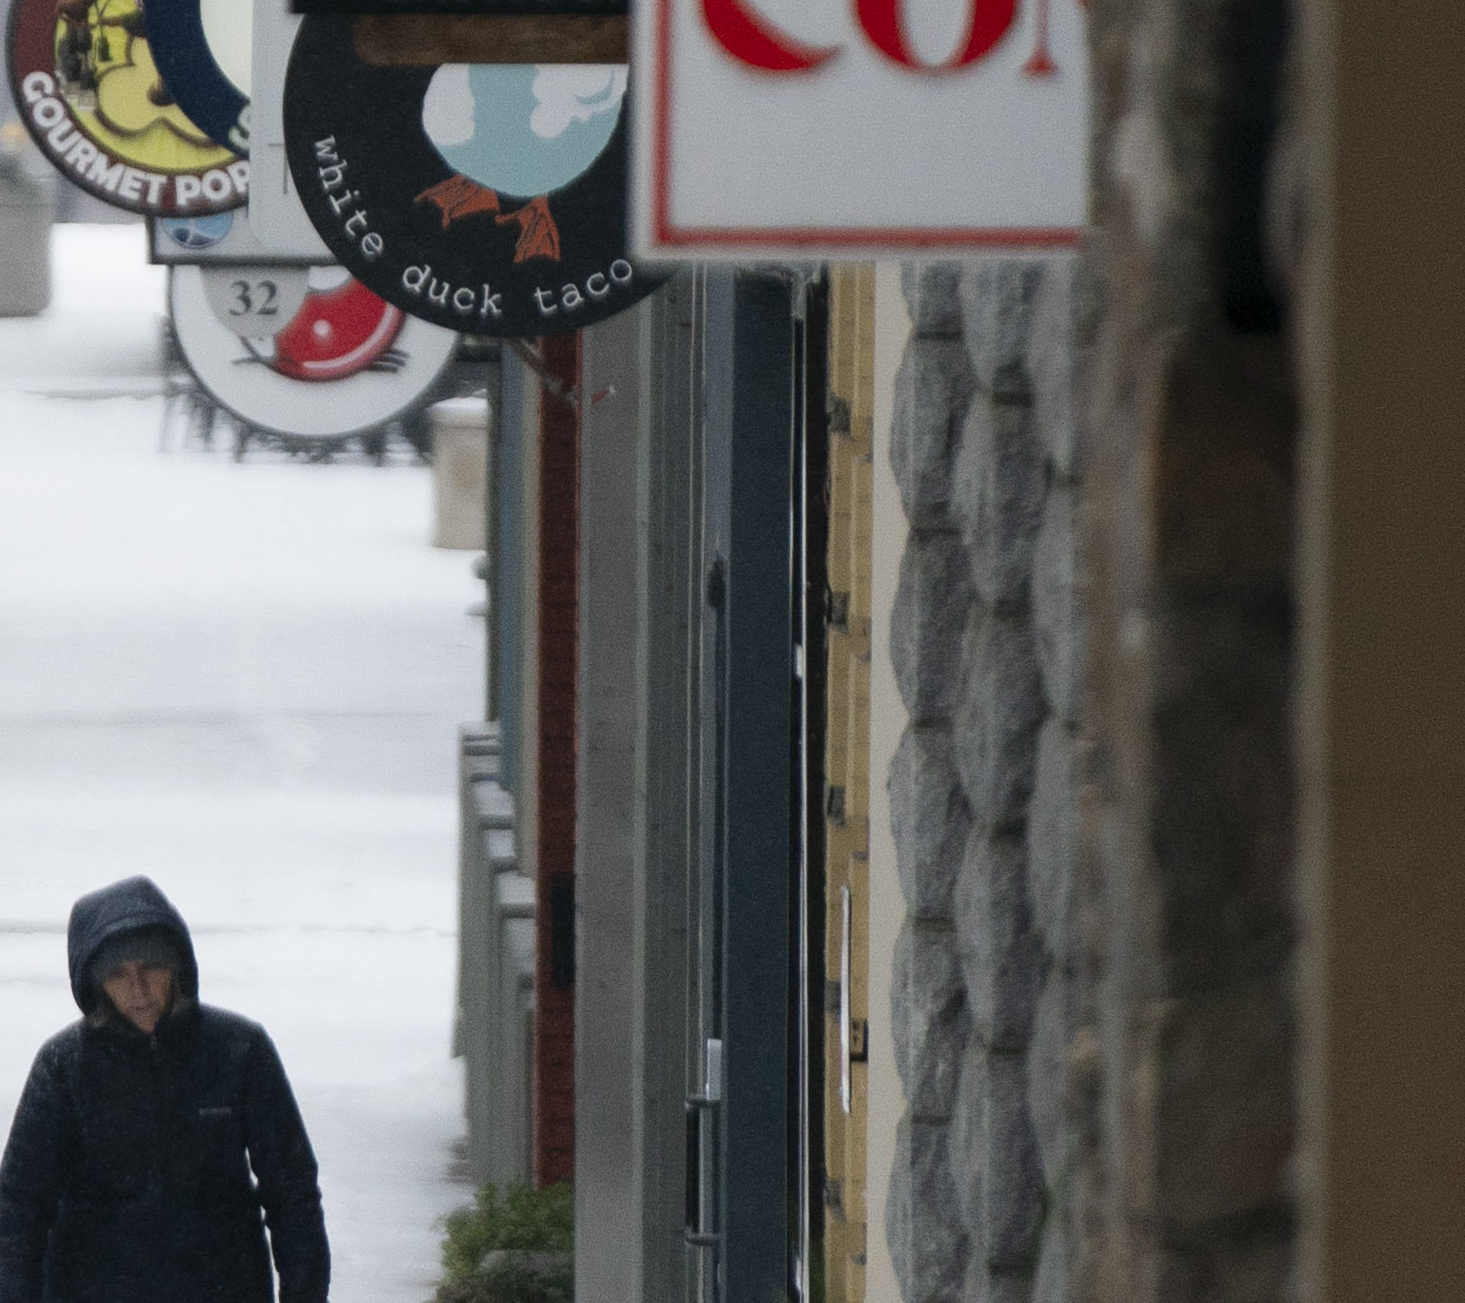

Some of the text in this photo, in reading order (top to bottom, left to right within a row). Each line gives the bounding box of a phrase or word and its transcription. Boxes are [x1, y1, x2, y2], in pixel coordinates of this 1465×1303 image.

[22, 70, 168, 205] GOURMET
[314, 134, 634, 317] white duck taco
[228, 279, 280, 317] 32
